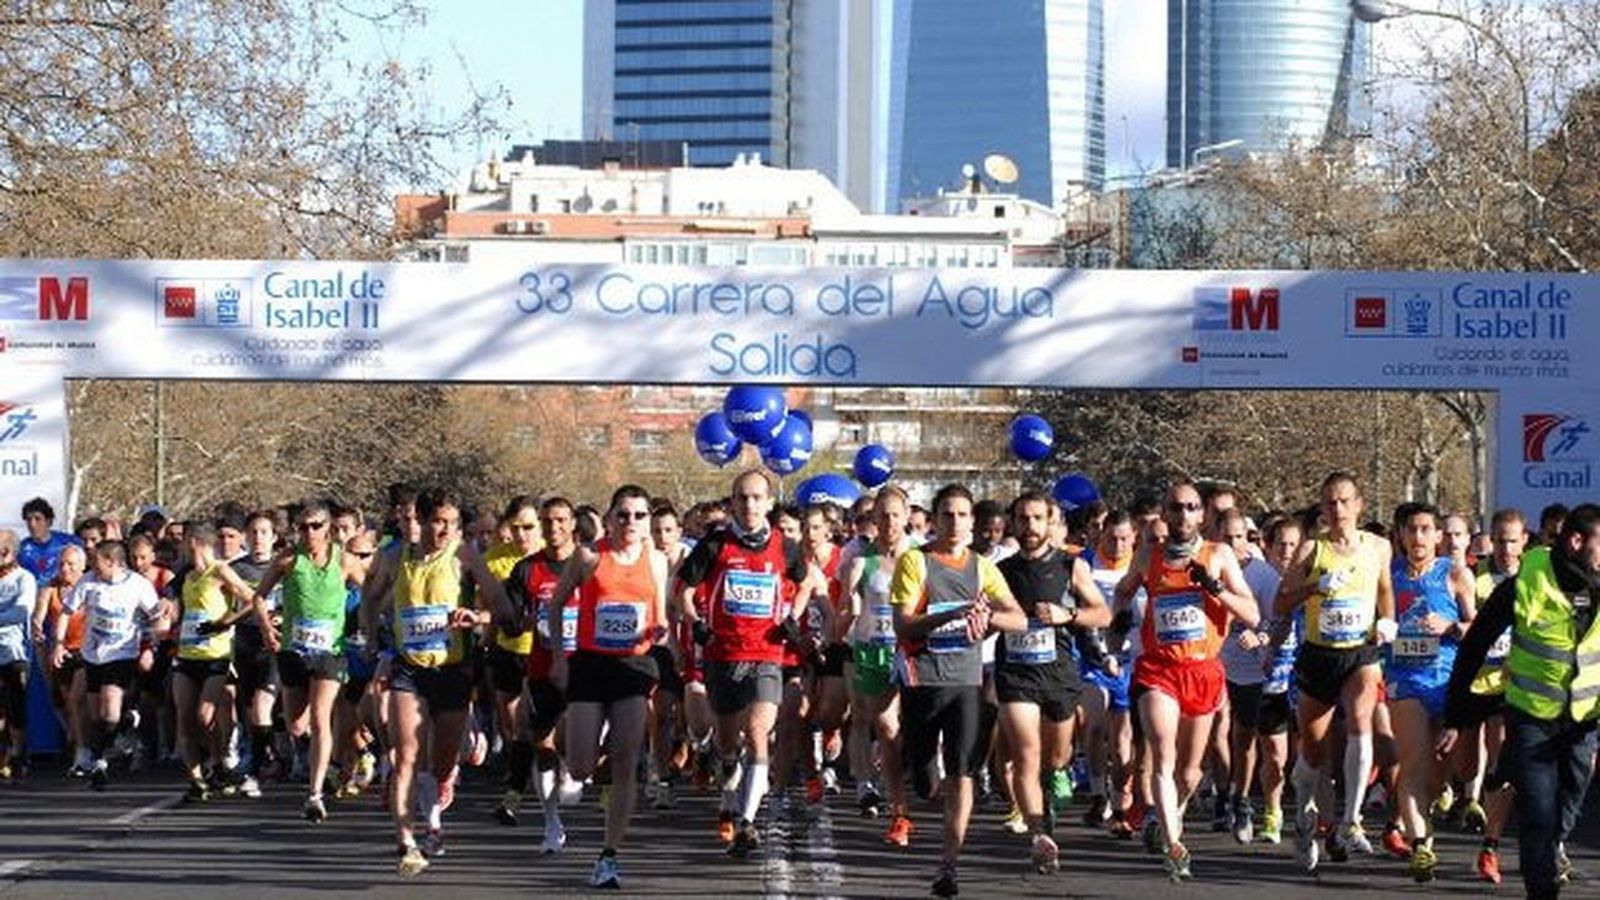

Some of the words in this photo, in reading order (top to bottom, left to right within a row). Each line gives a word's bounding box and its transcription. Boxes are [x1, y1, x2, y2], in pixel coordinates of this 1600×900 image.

[264, 271, 343, 300] Canal
[350, 273, 384, 300] de
[516, 271, 573, 315] 33
[596, 273, 794, 316] Carrera
[816, 273, 893, 316] del
[917, 275, 1053, 328] Agua
[1453, 281, 1531, 310] Canal
[1537, 281, 1571, 310] de
[265, 301, 349, 329] Isabel
[362, 303, 380, 329] II
[1455, 312, 1537, 339] Isabel
[1550, 314, 1567, 339] II
[708, 333, 857, 379] Salida
[1524, 464, 1591, 488] Canal
